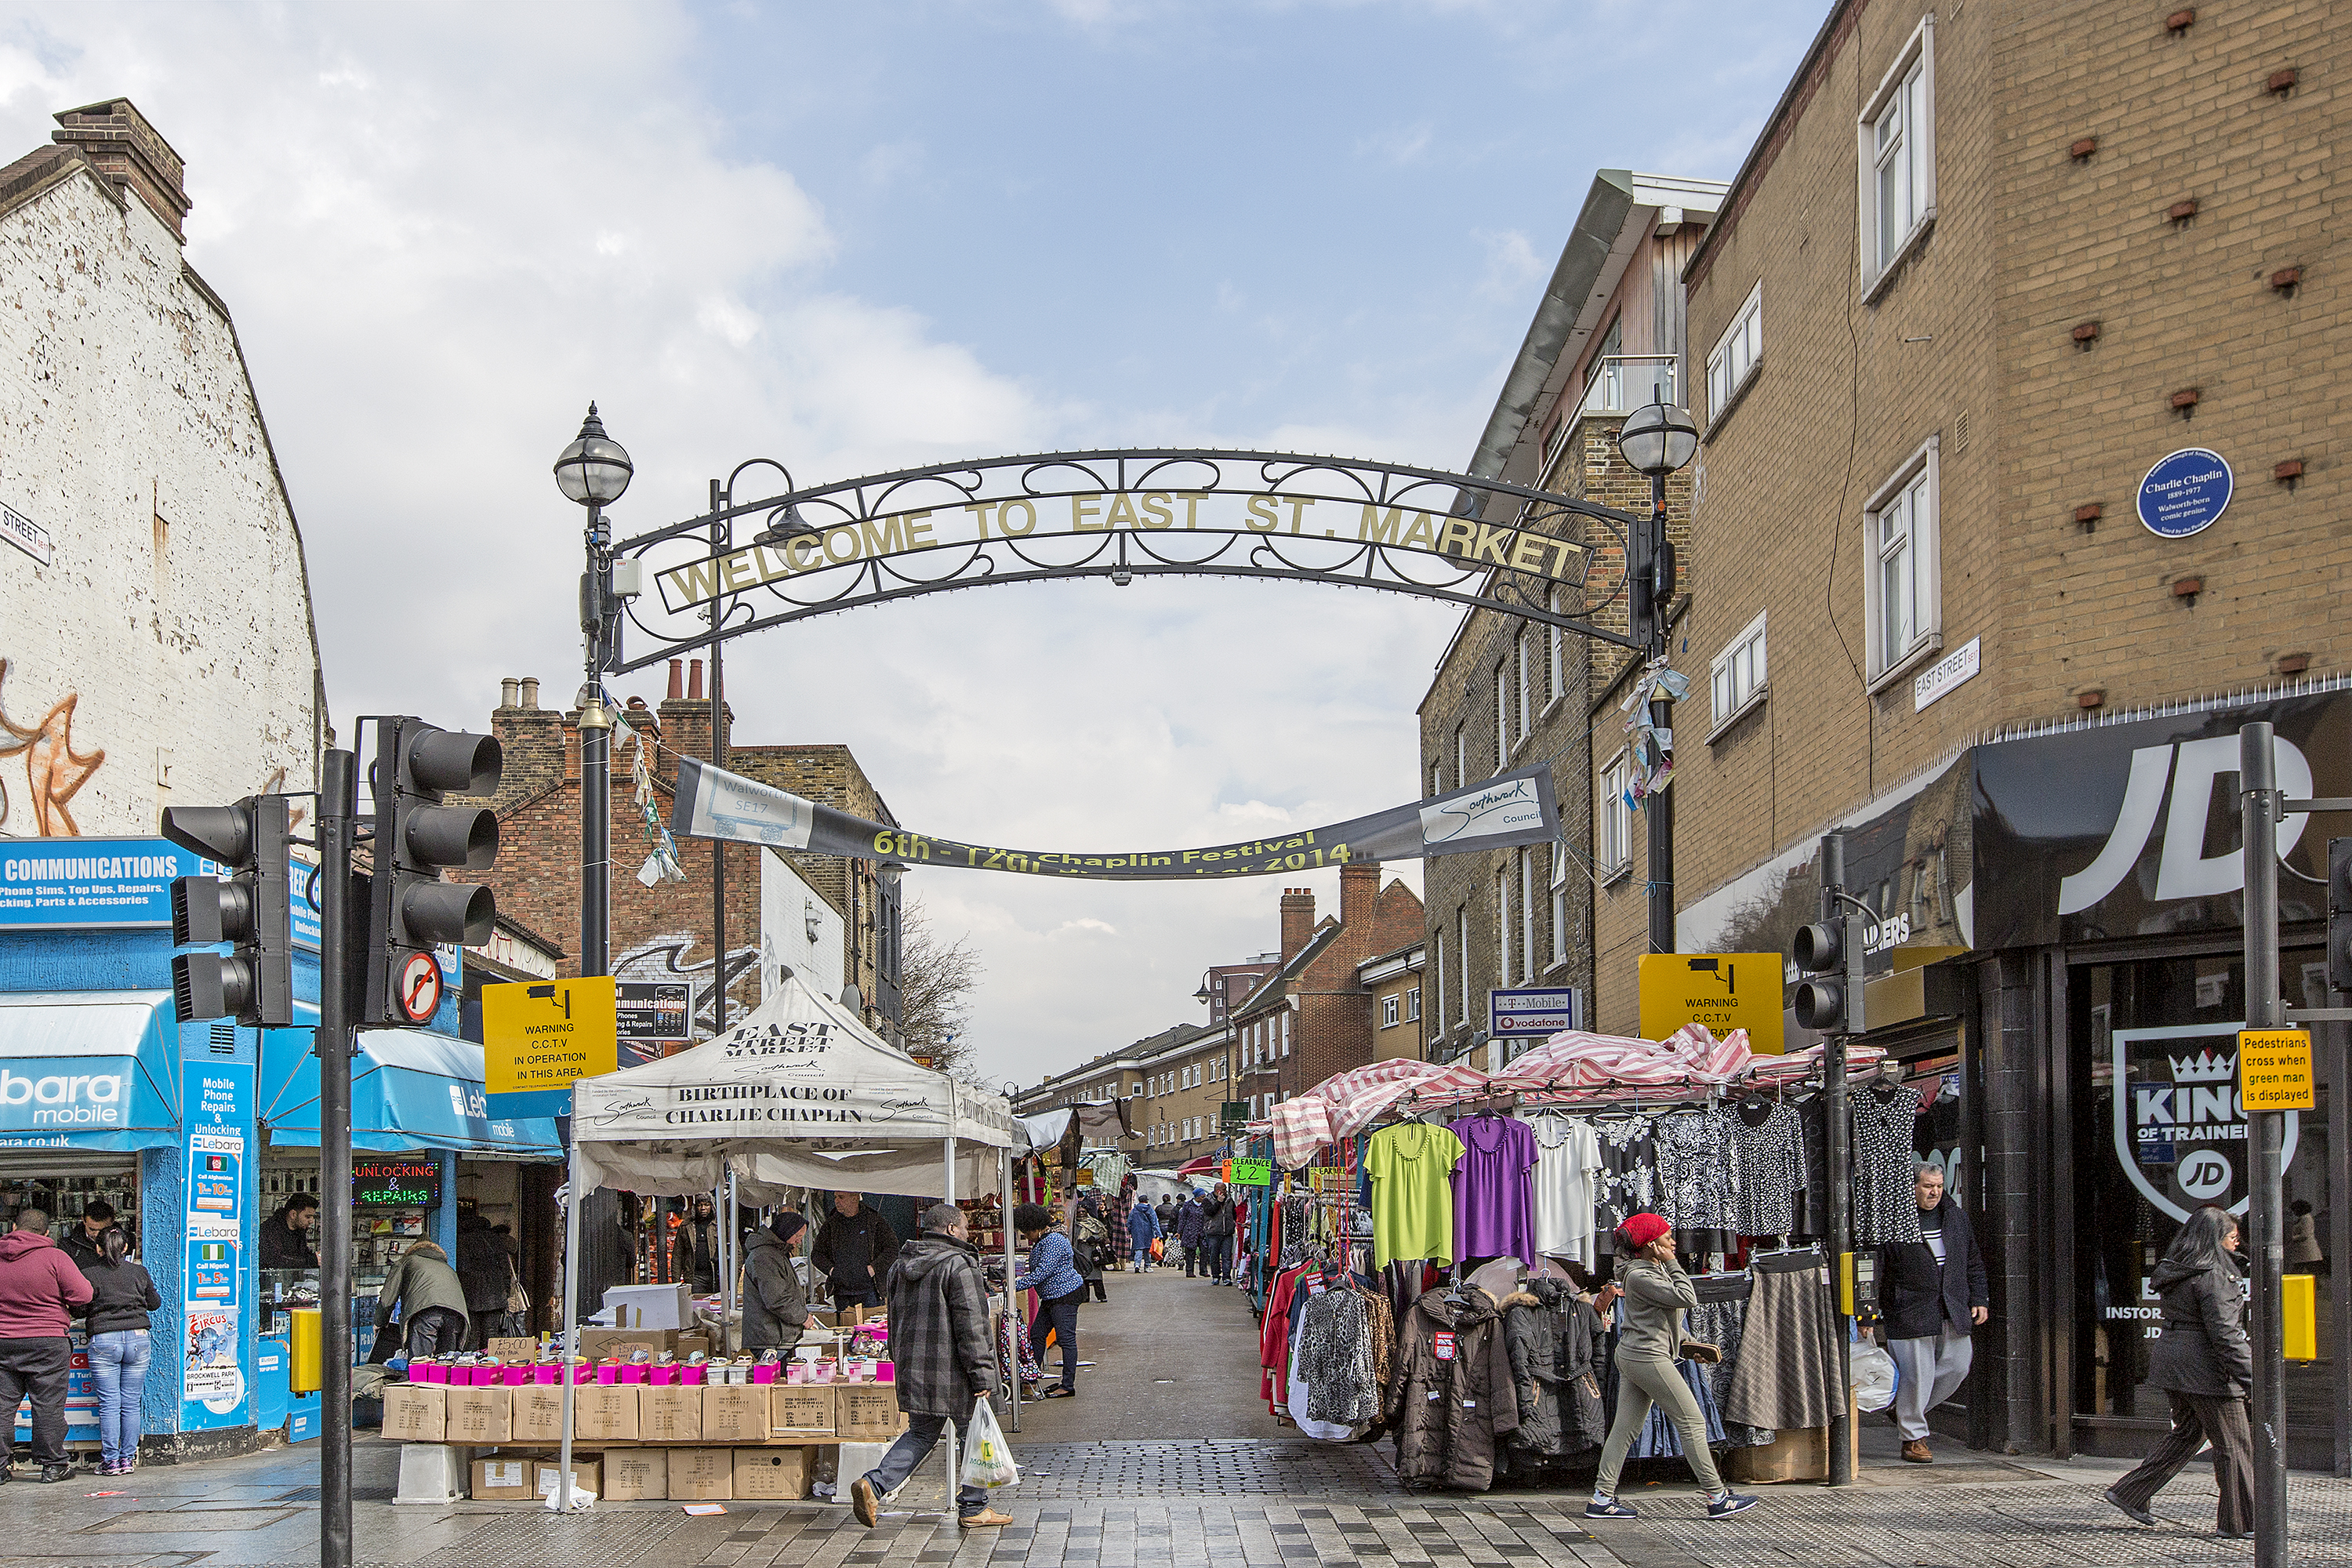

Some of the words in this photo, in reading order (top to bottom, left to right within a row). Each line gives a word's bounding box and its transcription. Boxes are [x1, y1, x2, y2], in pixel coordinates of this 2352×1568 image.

[2145, 479, 2182, 494] Charlie
[2183, 470, 2223, 485] Chaplin
[2167, 486, 2201, 500] 1889-1977
[2158, 497, 2211, 513] Walworth-born
[2161, 511, 2183, 521] comic
[3, 510, 38, 545] STREET
[668, 509, 938, 604] WELCOME
[964, 498, 1037, 541] TO
[1072, 492, 1208, 531] EAST
[1245, 494, 1334, 535] ST.
[1357, 503, 1582, 579] MARKET
[1916, 670, 1936, 697] EAST
[1937, 648, 1969, 683] STREET
[722, 780, 788, 801] Walworth
[735, 800, 768, 815] SE17
[1423, 780, 1529, 844] Southwark
[1503, 811, 1541, 824] Council
[2058, 734, 2313, 915] JD
[873, 830, 930, 860] 6th
[1264, 843, 1351, 872] 2014
[1182, 831, 1315, 864] Festival
[5, 855, 178, 881] COMMUNICATIONS
[35, 886, 67, 896] Sims,
[69, 885, 89, 895] Top
[93, 884, 116, 895] Ups,
[118, 883, 165, 894] Repairs,
[36, 897, 65, 906] Parts
[78, 895, 149, 906] Accessories
[1685, 998, 1739, 1007] WARNING
[524, 1023, 575, 1035] WARNING
[1515, 1018, 1566, 1027] vodafone
[733, 1022, 839, 1041] EAST
[724, 1036, 834, 1050] STREET
[2245, 1038, 2307, 1050] Pedestrians
[514, 1056, 524, 1065] IN
[527, 1052, 586, 1065] OPERATION
[721, 1046, 833, 1058] MARKET
[2246, 1058, 2274, 1066] cross
[2278, 1054, 2306, 1065] when
[517, 1071, 528, 1080] IN
[530, 1069, 554, 1078] THIS
[556, 1067, 584, 1077] AREA
[2249, 1074, 2279, 1086] green
[2283, 1073, 2305, 1083] man
[203, 1077, 235, 1090] Mobile
[204, 1089, 234, 1102] Phone
[678, 1085, 818, 1102] BIRTHPLACE
[822, 1087, 853, 1102] OF
[2246, 1091, 2255, 1101] is
[2259, 1090, 2309, 1102] displayed
[201, 1100, 236, 1114] Repairs
[33, 1105, 118, 1123] mobile
[214, 1113, 223, 1123] &
[666, 1108, 762, 1124] CHARLIE
[766, 1107, 862, 1123] CHAPLIN
[194, 1123, 241, 1137] Unlocking
[2137, 1127, 2158, 1138] OF
[202, 1138, 241, 1151] Lebara
[1232, 1158, 1270, 1167] CLEARANCE
[355, 1166, 434, 1177] UNLOCKING
[1236, 1165, 1260, 1181] £2
[2186, 1162, 2224, 1187] JD
[389, 1177, 399, 1190] &
[198, 1226, 238, 1237] Lebara
[189, 1314, 227, 1335] CIRCUS
[2143, 1327, 2161, 1339] JD
[187, 1371, 220, 1380] BROCKWELL
